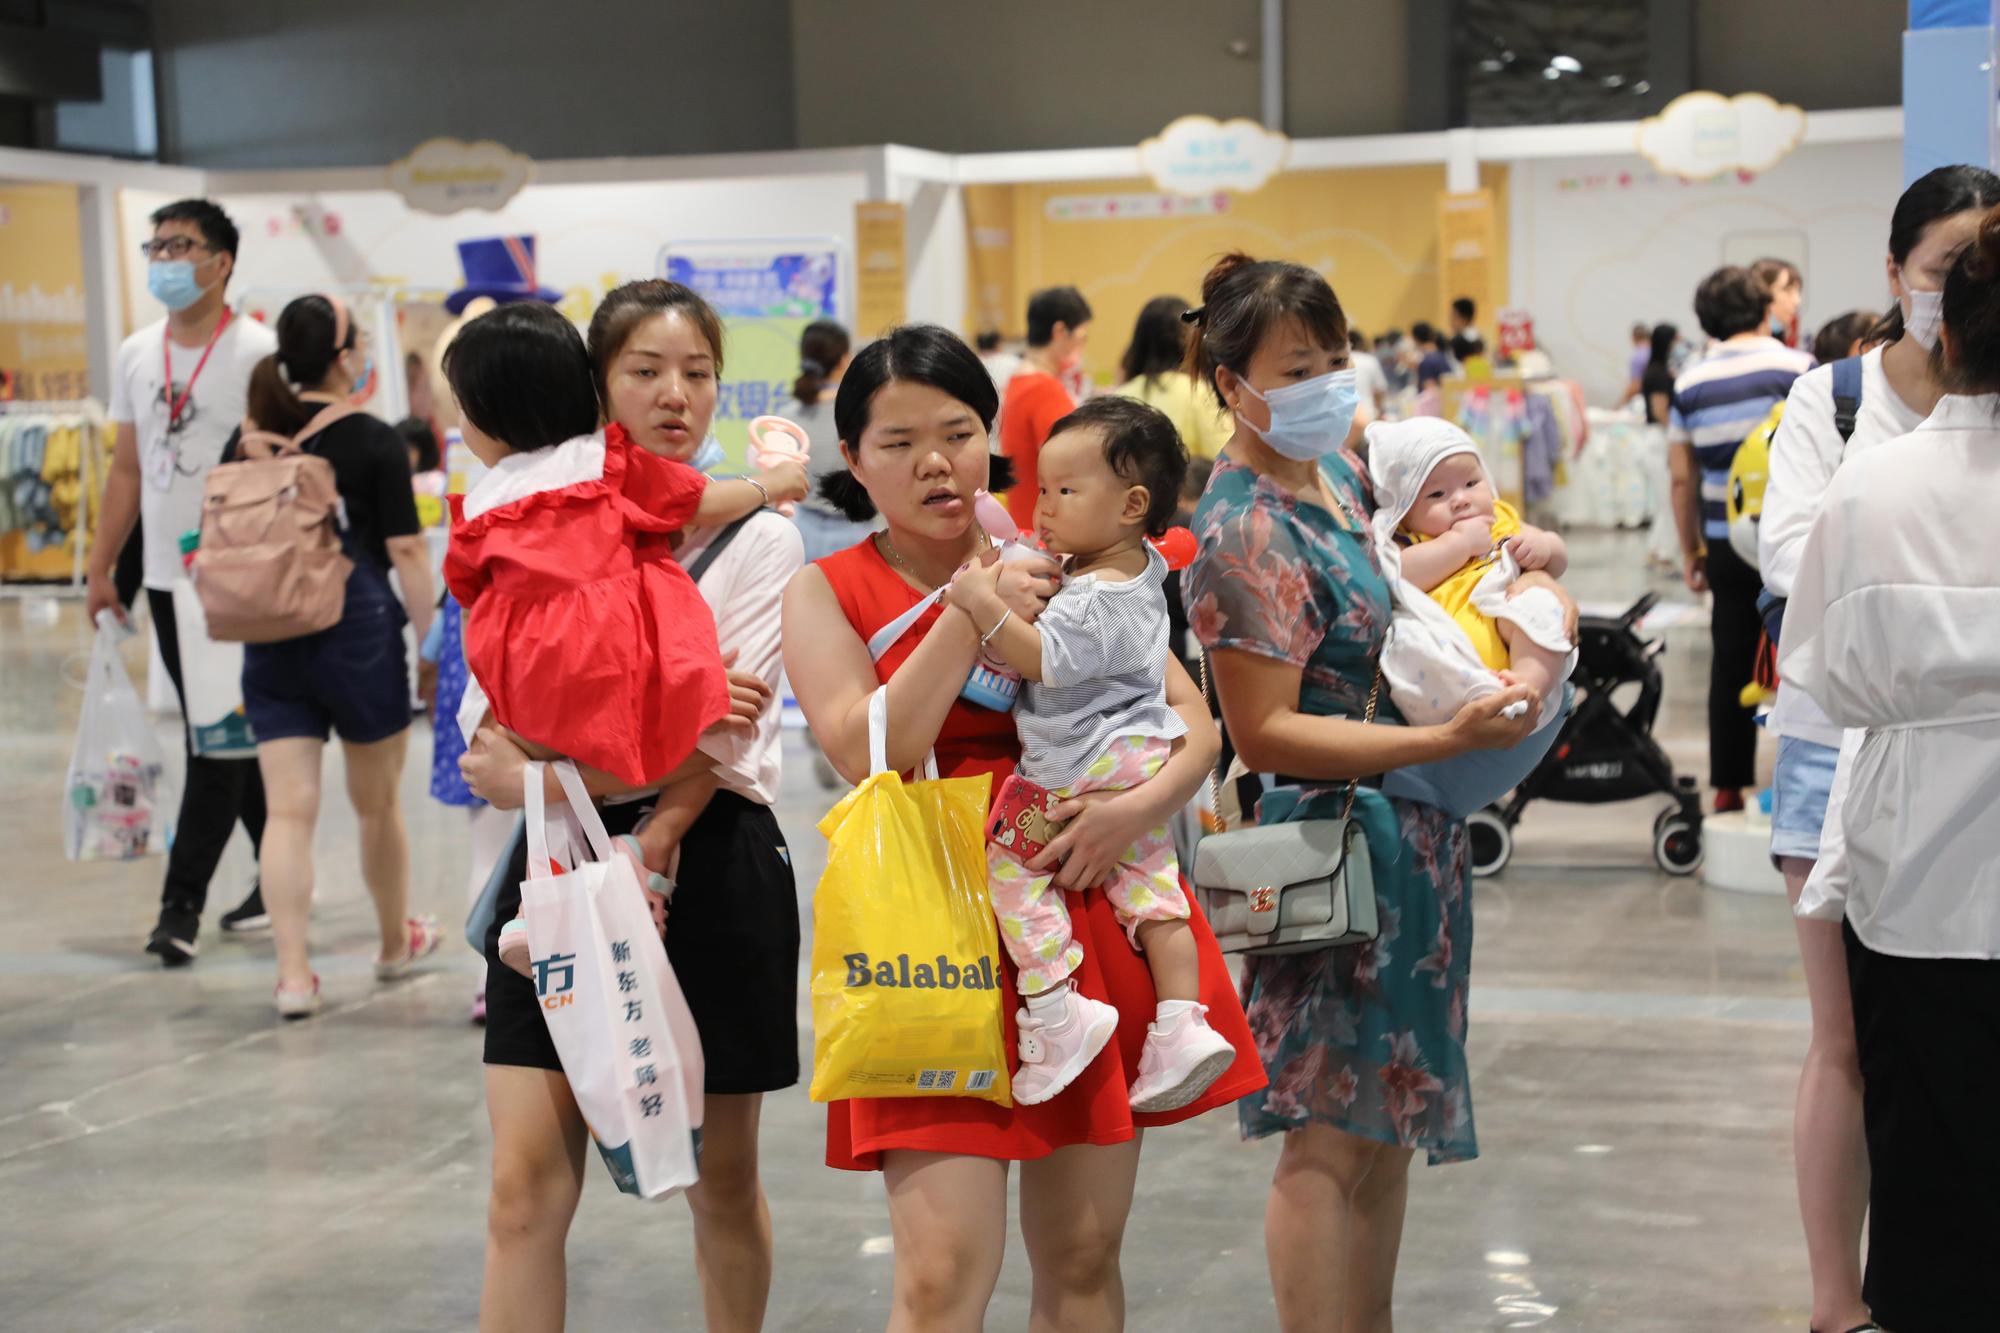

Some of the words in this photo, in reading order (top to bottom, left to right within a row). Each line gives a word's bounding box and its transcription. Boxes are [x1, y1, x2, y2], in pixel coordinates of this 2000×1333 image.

[531, 953, 576, 996] 方
[544, 994, 574, 1010] CN
[611, 940, 643, 1023] 新东方
[629, 1036, 664, 1119] 老师好
